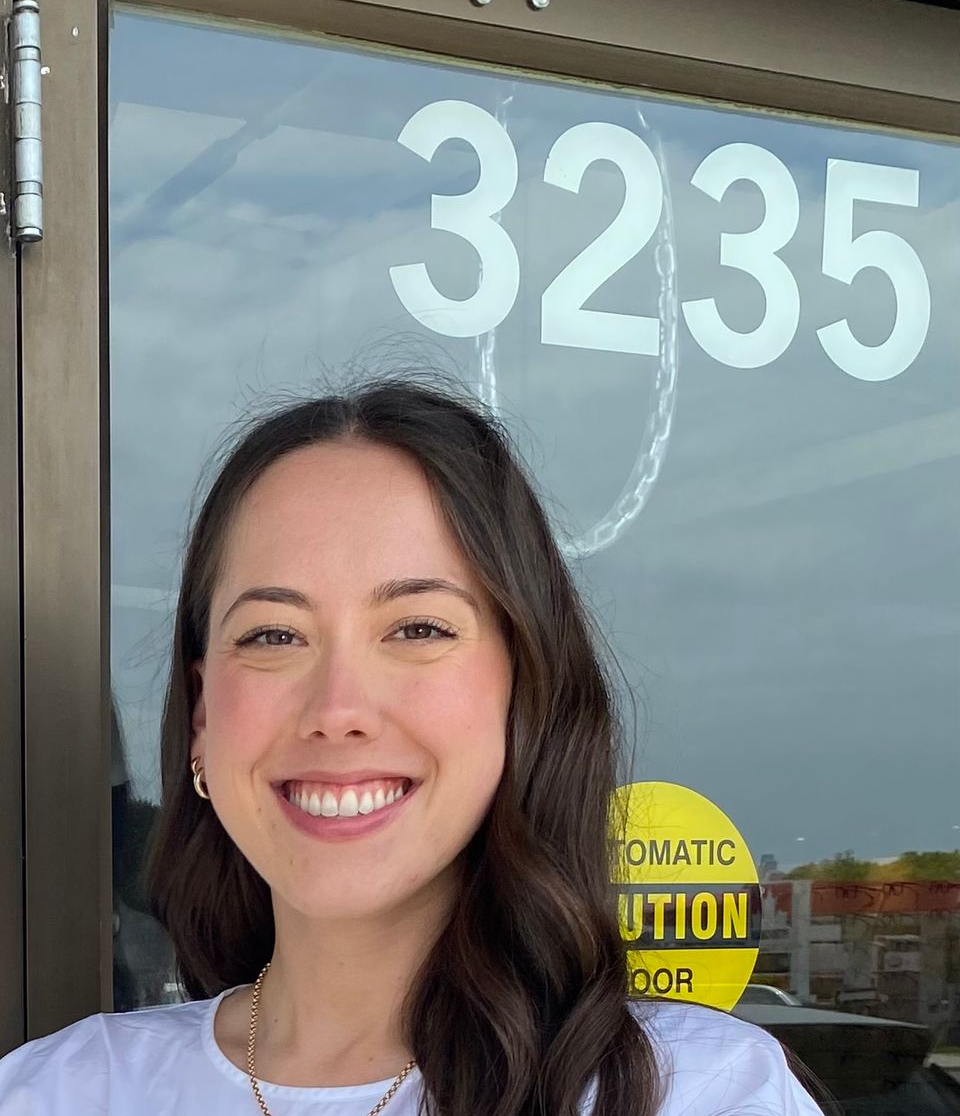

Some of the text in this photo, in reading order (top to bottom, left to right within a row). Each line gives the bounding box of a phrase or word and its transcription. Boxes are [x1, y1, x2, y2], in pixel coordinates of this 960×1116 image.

[389, 100, 931, 381] 3235
[607, 839, 736, 866] TOMATIC
[618, 892, 748, 940] UTION
[630, 967, 693, 994] OOR
